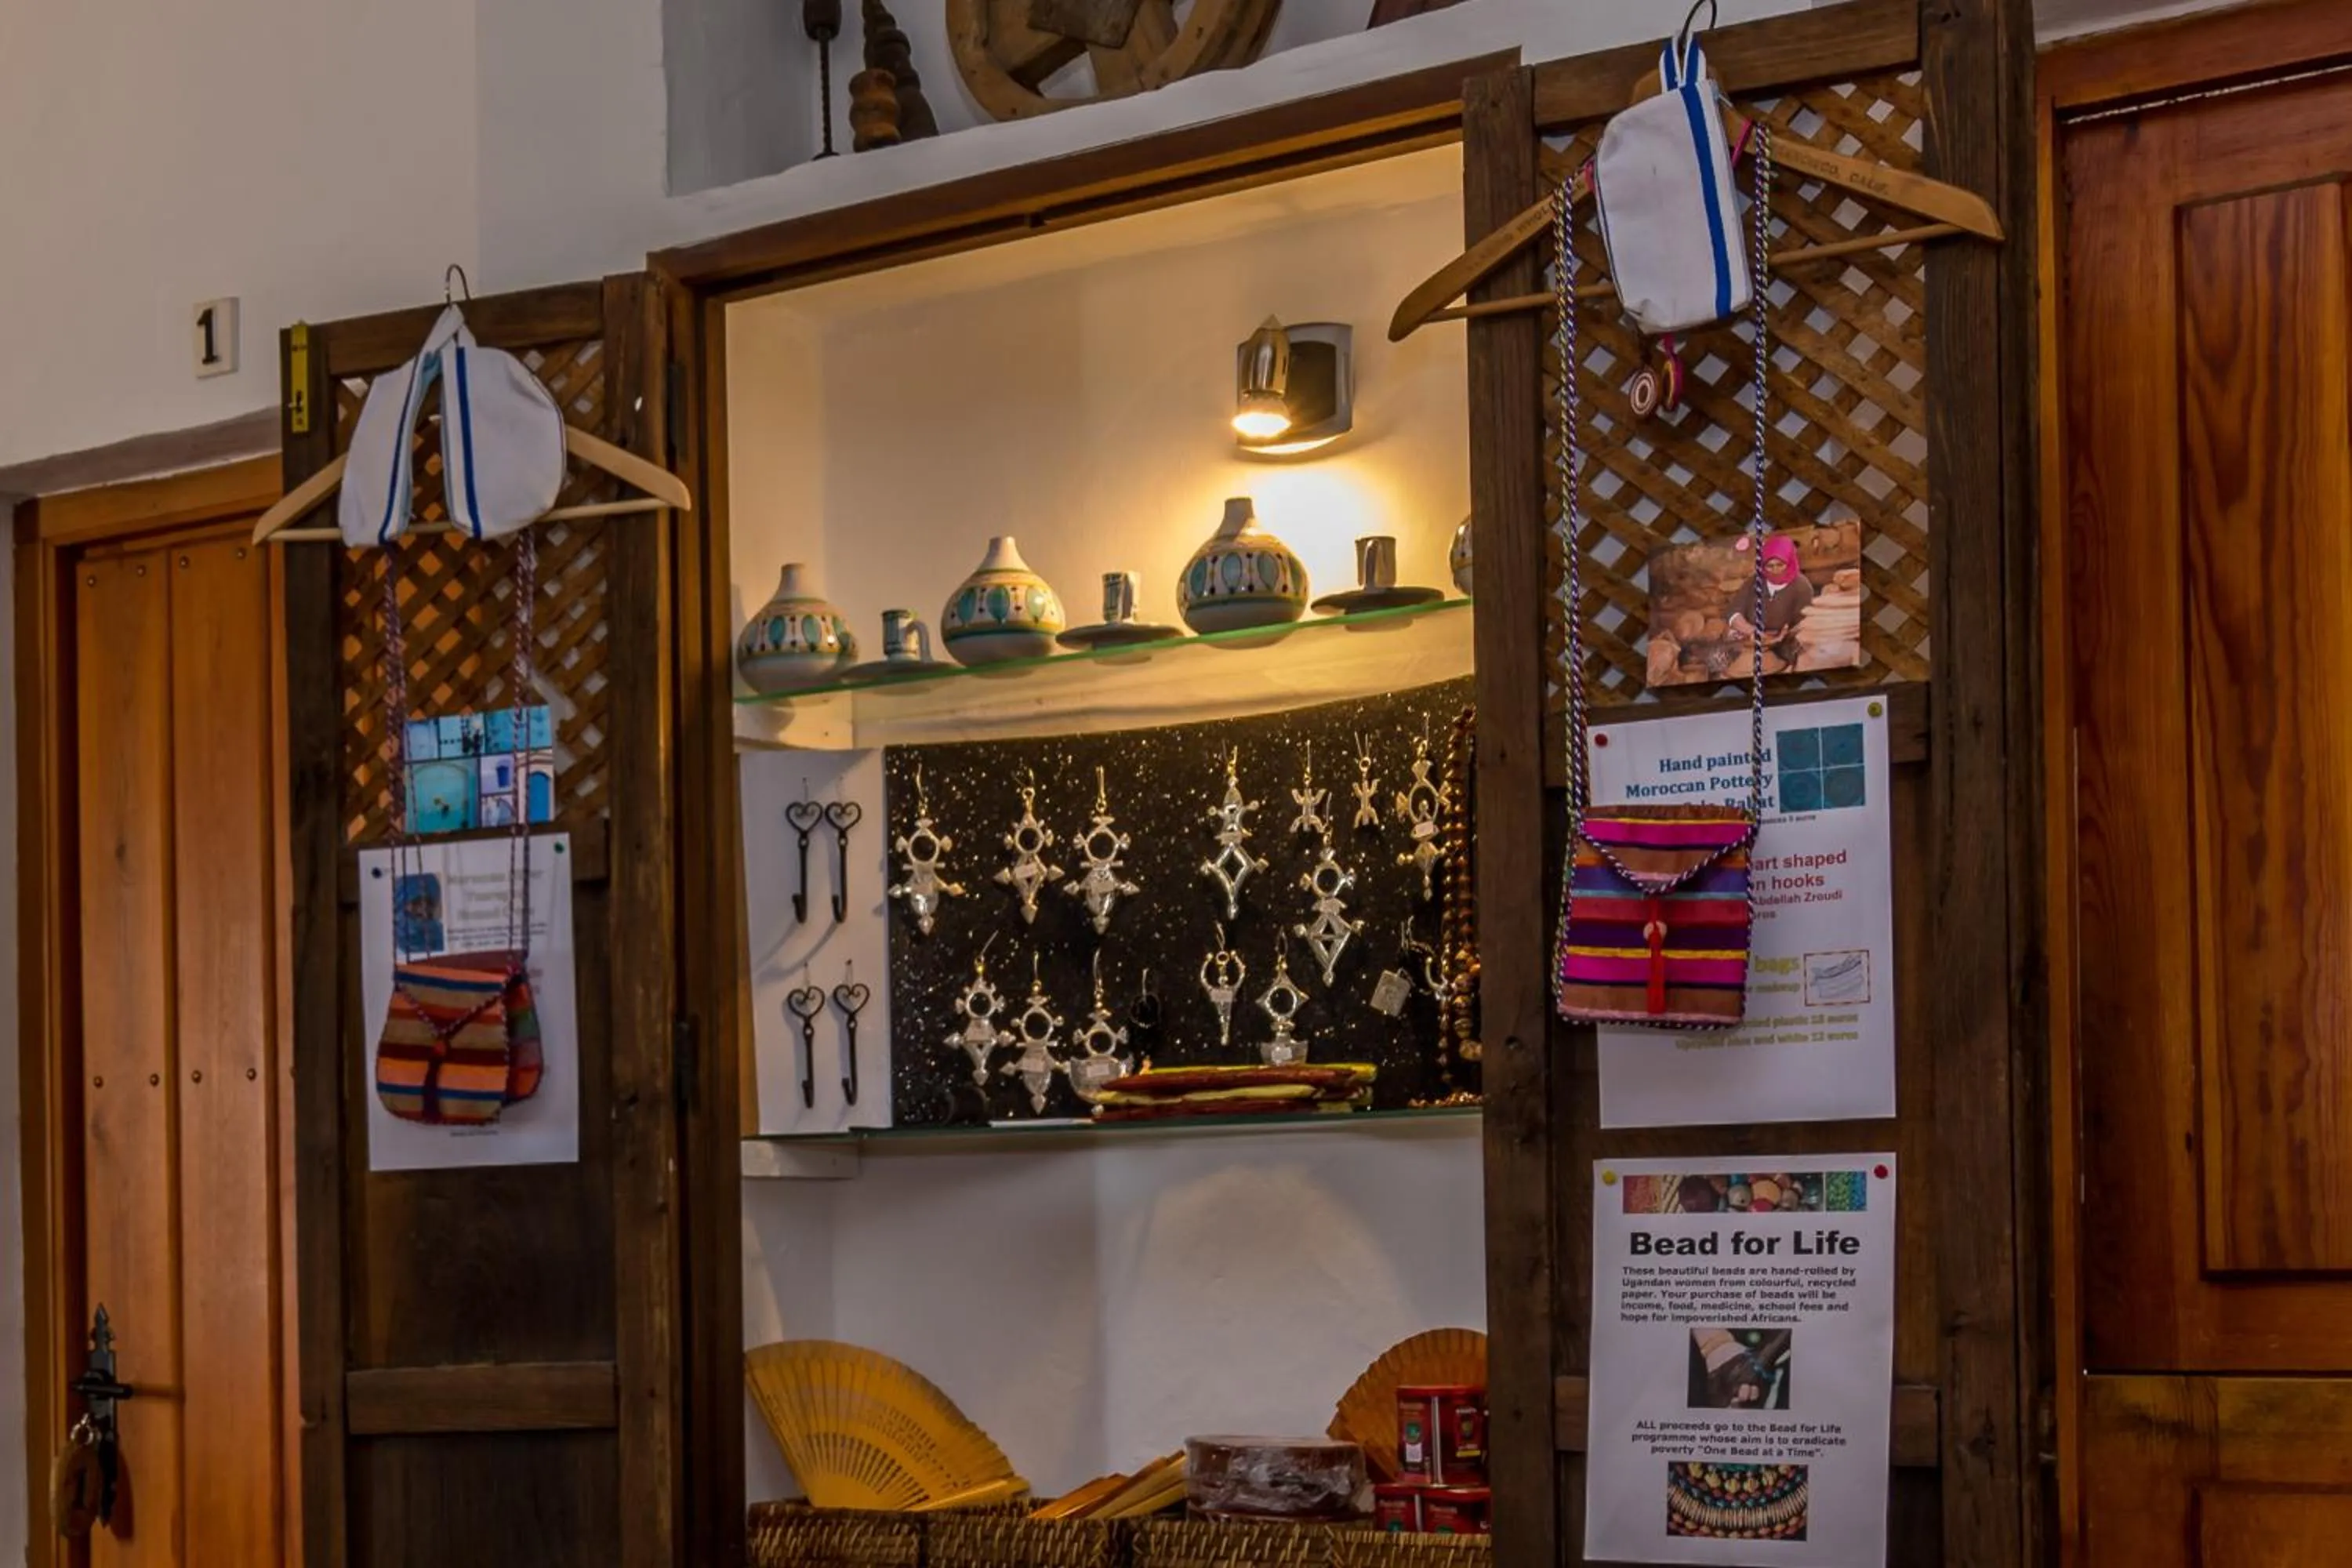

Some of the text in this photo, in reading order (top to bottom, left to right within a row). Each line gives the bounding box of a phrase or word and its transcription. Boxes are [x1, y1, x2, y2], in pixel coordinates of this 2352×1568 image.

[196, 307, 221, 365] 1
[1659, 748, 1772, 773] Hand paintd
[1625, 773, 1773, 798] Moroccan Pottey
[1783, 849, 1847, 869] shaped
[1772, 873, 1825, 890] hooks
[1630, 1230, 1860, 1256] Bead for Life
[1623, 1266, 1857, 1277] These beautiful beads are hand-rolled by
[1622, 1278, 1671, 1288] Ugandan
[1719, 1278, 1746, 1287] from
[1749, 1278, 1804, 1288] colourful,
[1807, 1278, 1857, 1289] recycled
[1621, 1290, 1836, 1300] paper. Your purchase of beads will be
[1621, 1301, 1849, 1311] income, food, medicine, school fees and
[1621, 1312, 1802, 1323] hope for impoverished Africans.
[1636, 1421, 1842, 1434] ALL proceeds go to the Bead for Life
[1632, 1434, 1847, 1446] programme whose aim is to eradicate
[1650, 1446, 1694, 1455] poverty
[1730, 1446, 1759, 1456] Bead
[1762, 1447, 1773, 1456] at
[1777, 1448, 1784, 1457] a
